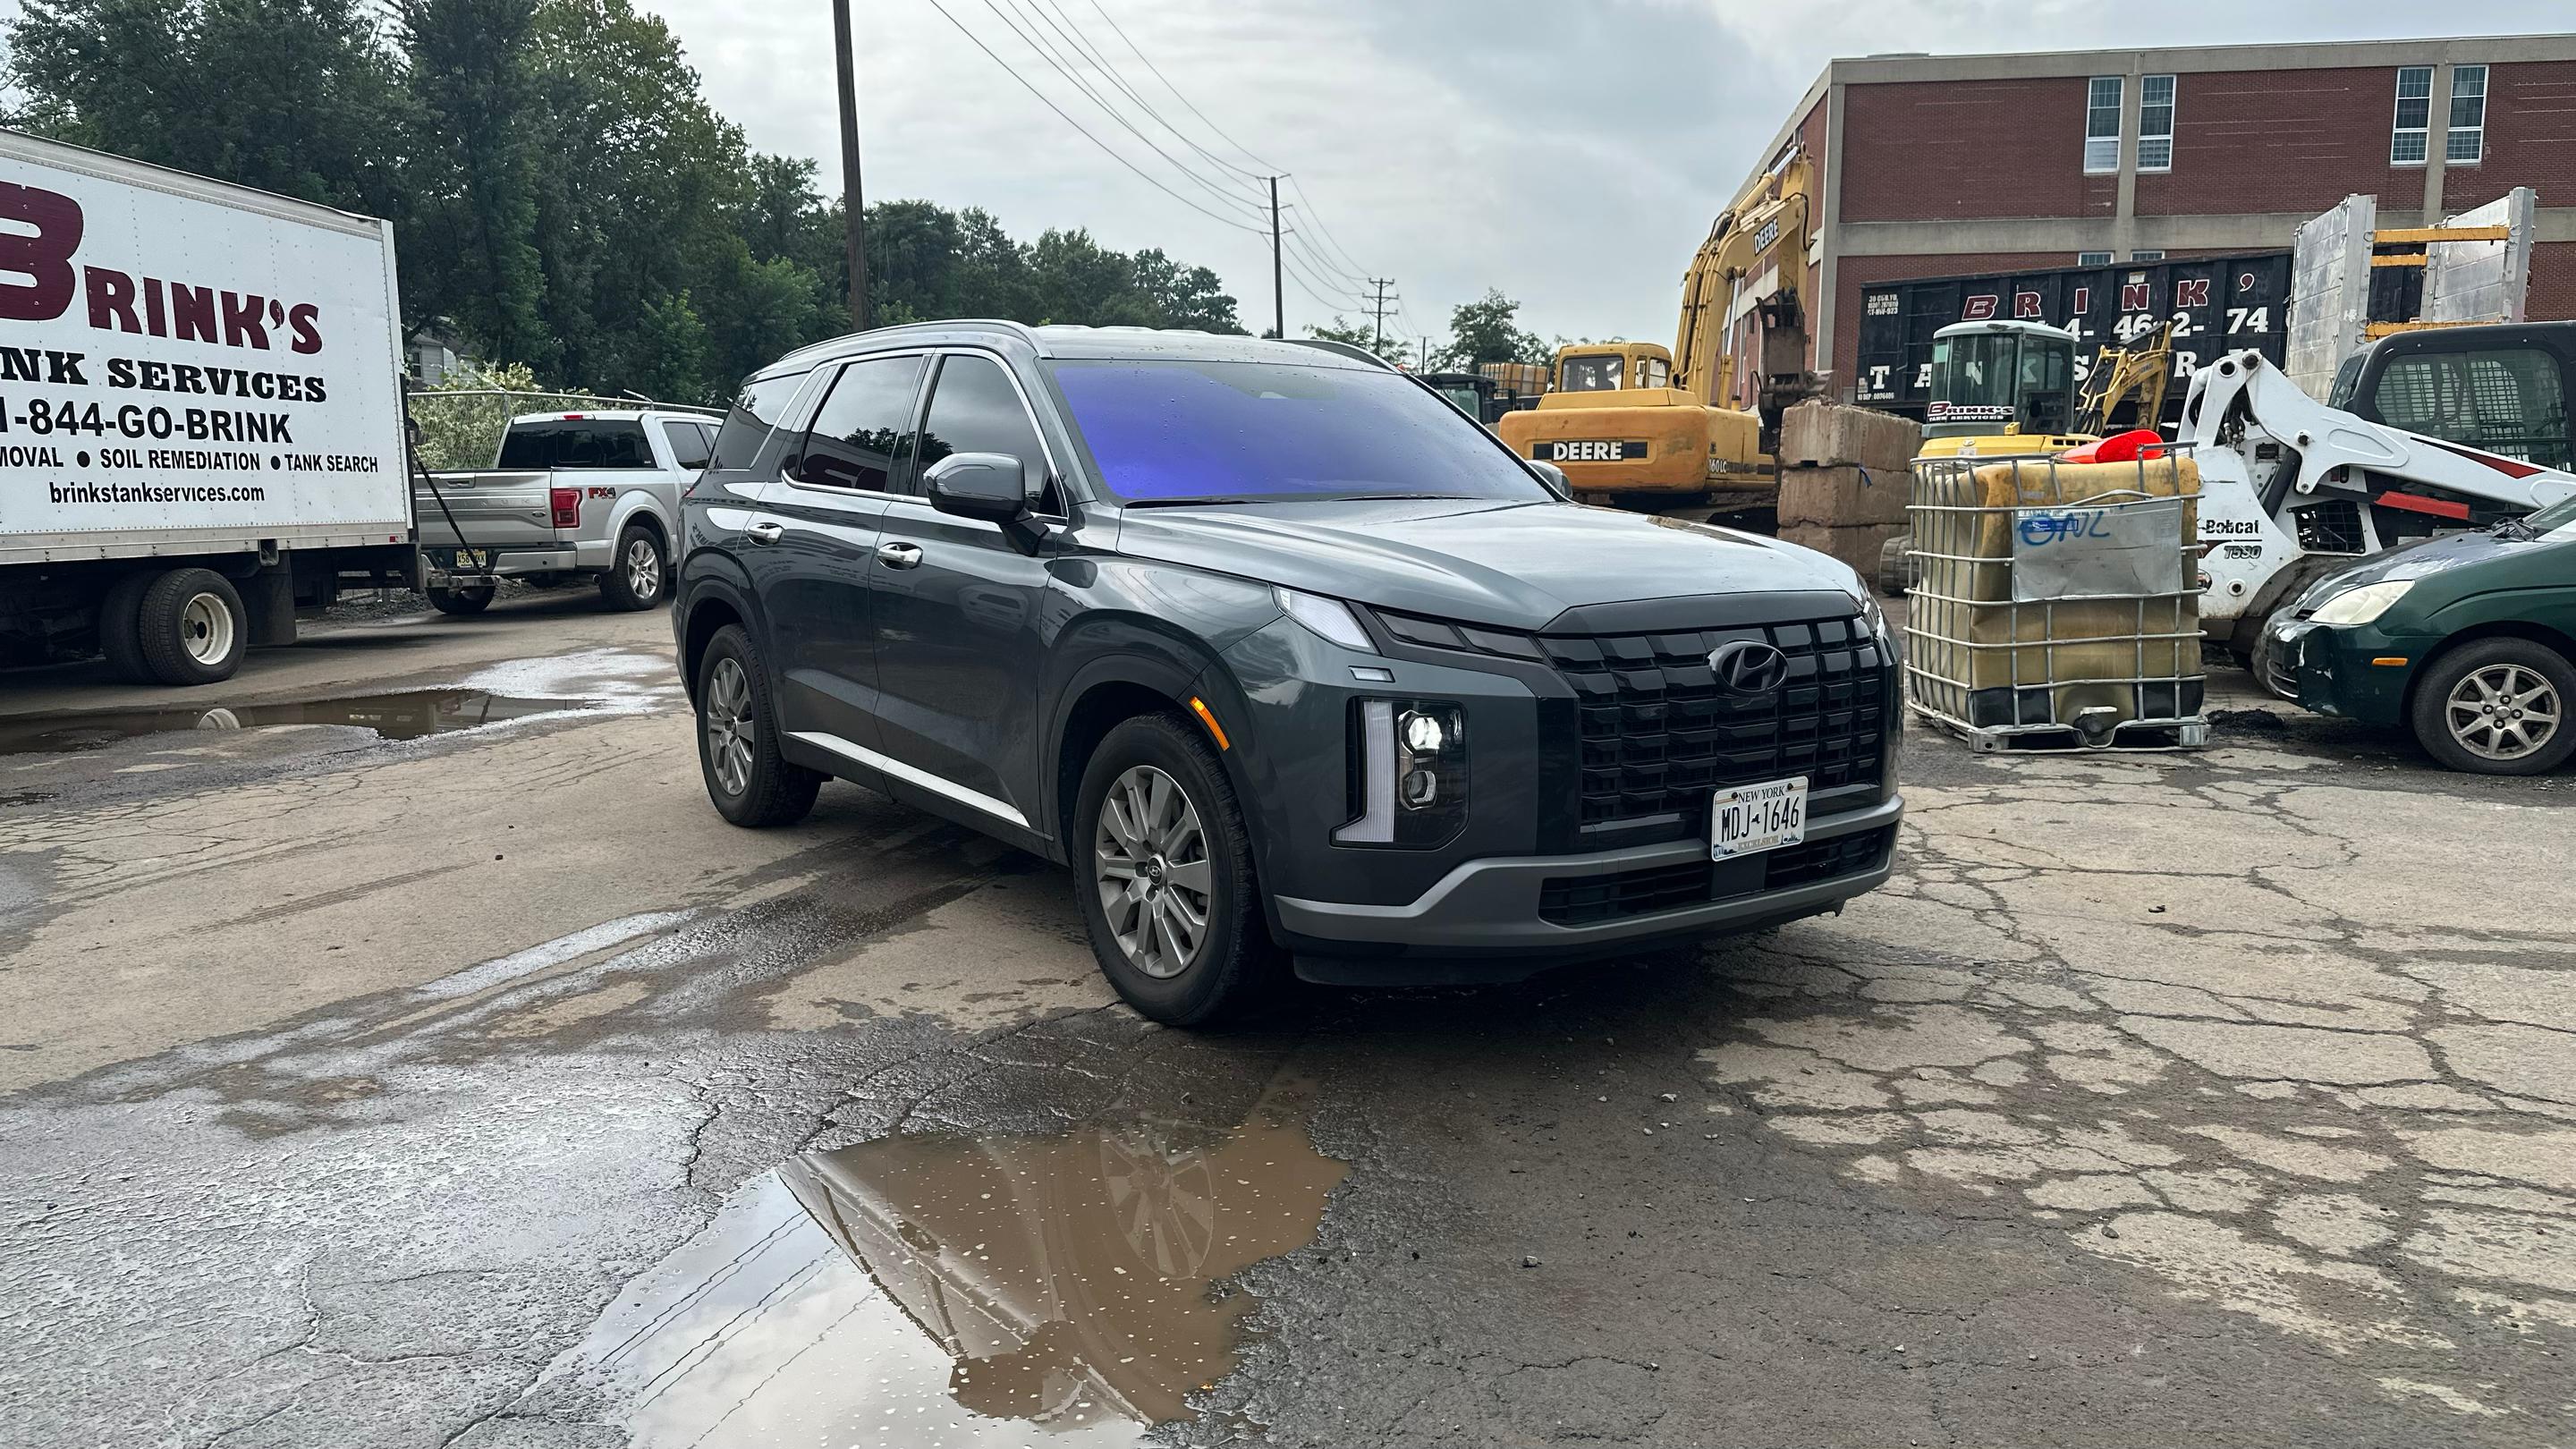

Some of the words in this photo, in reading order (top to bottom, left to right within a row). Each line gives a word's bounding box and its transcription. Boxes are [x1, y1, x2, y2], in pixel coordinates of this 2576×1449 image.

[1754, 218, 1778, 256] DEERE
[0, 182, 323, 355] BRINK'S
[107, 358, 326, 402] SERVICES
[1928, 401, 2014, 417] BRINK'S
[0, 396, 292, 444] 1-844-GO-BRINK
[100, 448, 143, 469] SOIL
[148, 449, 260, 470] REMEDIATION
[284, 453, 323, 471] TANK
[326, 454, 378, 473] SEARCH
[1553, 441, 1623, 461] DEERE
[49, 481, 265, 504] brinkstankservices.com
[588, 487, 616, 499] FX4
[2206, 519, 2259, 534] Bobcat
[2224, 546, 2263, 559] T590
[1738, 790, 1760, 803] NEW
[1762, 786, 1785, 800] YORK
[1738, 835, 1779, 851] EXCELSIOR
